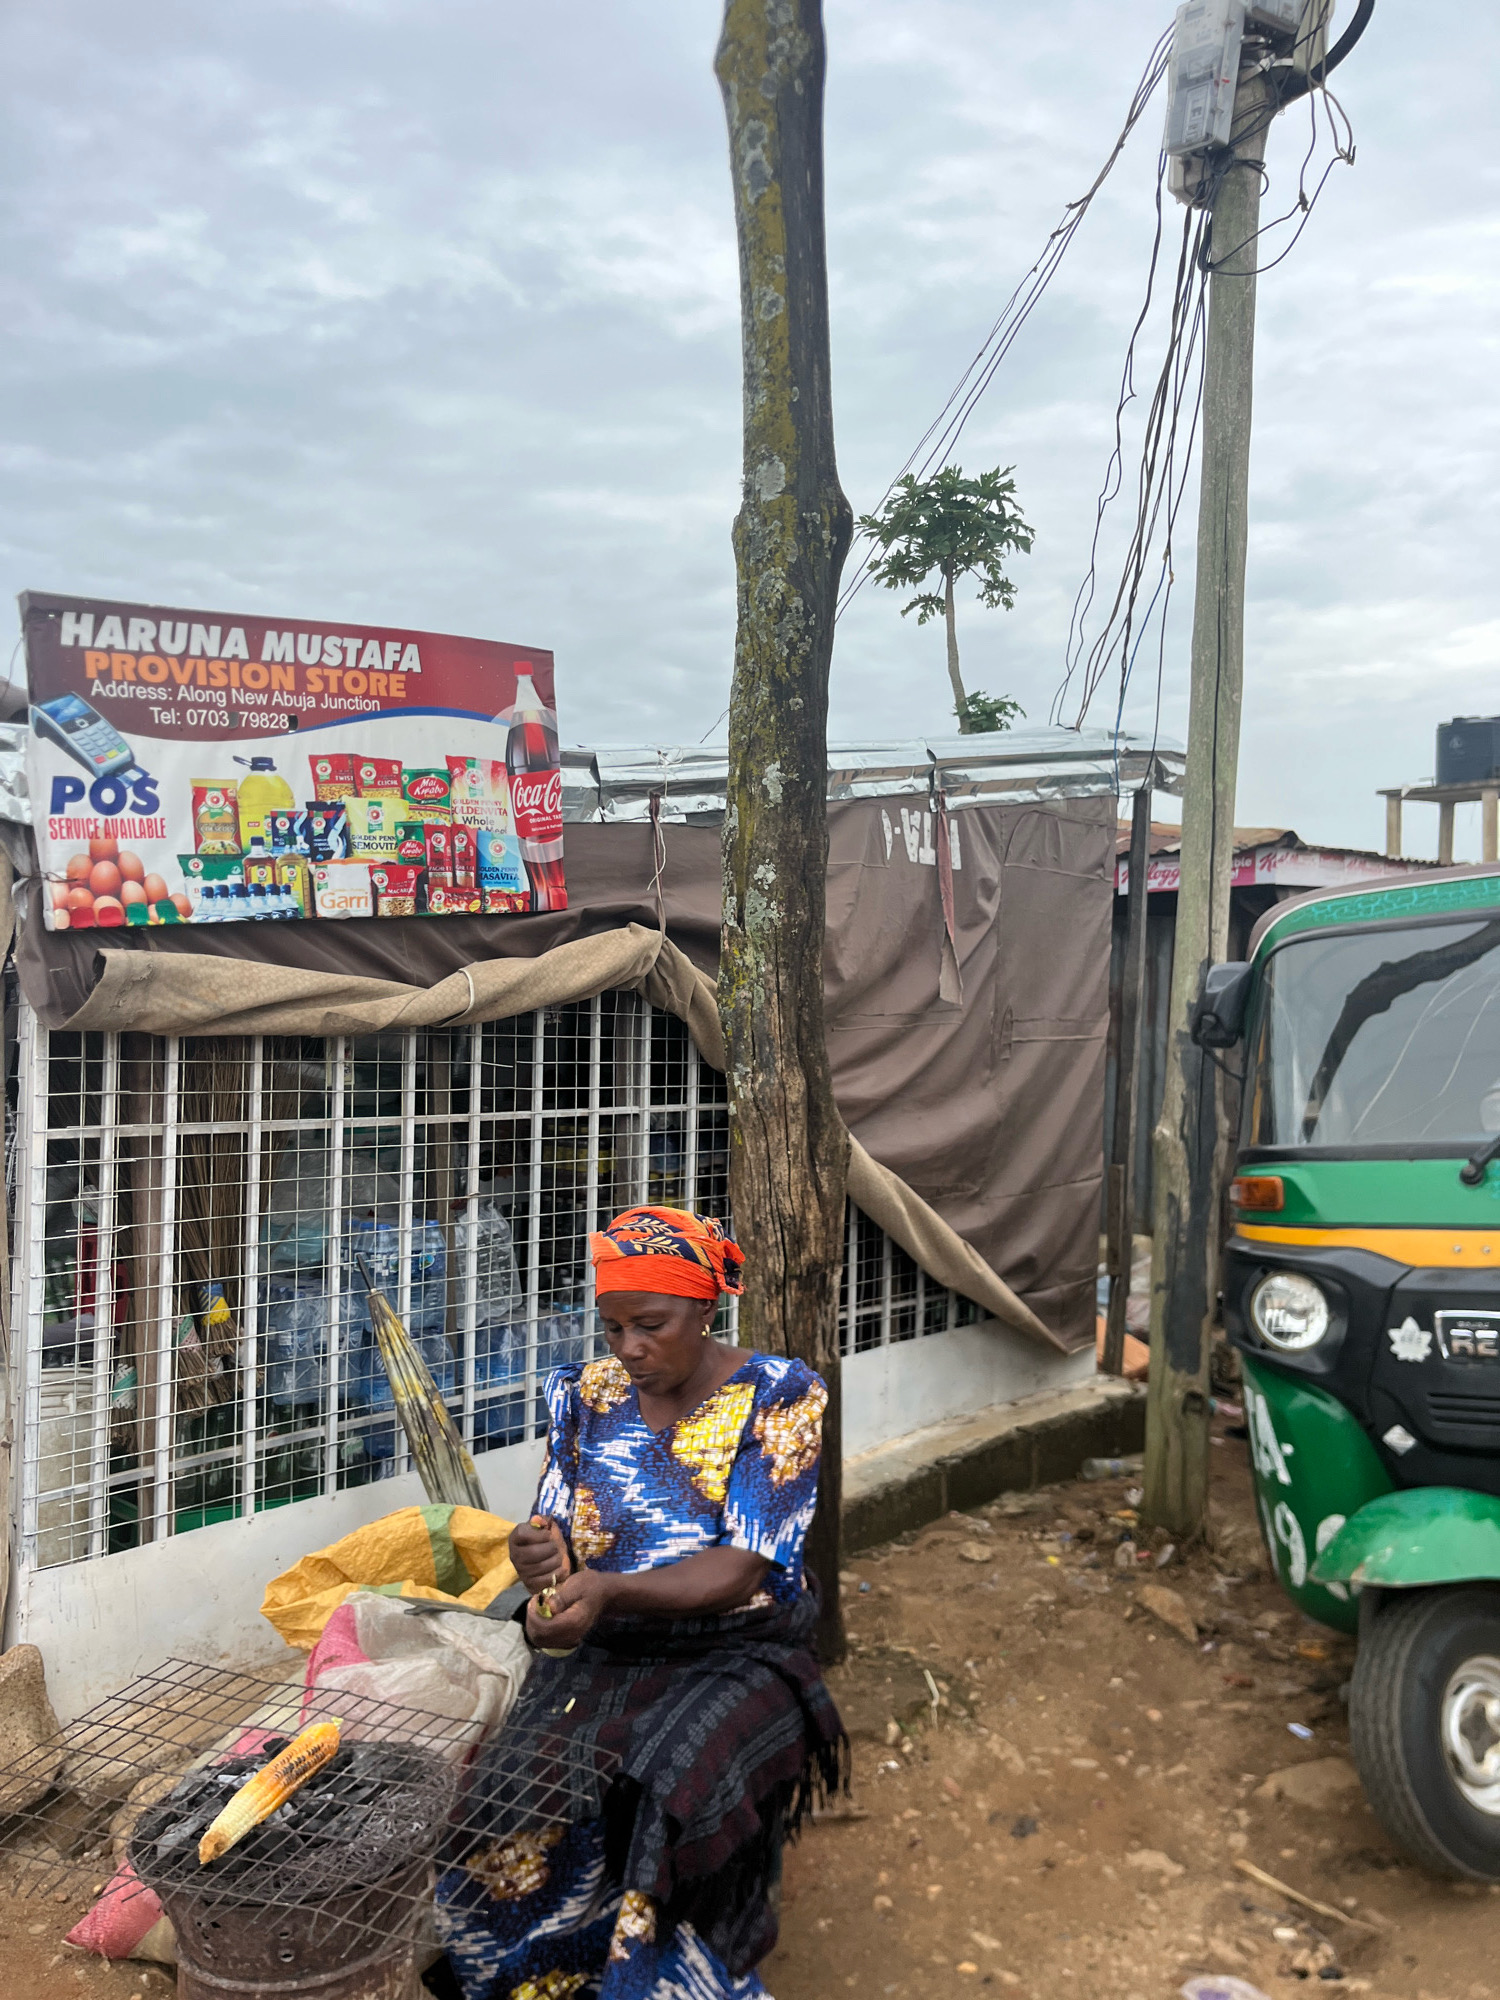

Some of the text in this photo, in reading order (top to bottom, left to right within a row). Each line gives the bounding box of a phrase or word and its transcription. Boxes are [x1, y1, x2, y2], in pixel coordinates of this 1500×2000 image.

[60, 611, 422, 674] HARUNA MUSTAFA
[84, 651, 406, 698] PROVISION STORE
[91, 679, 381, 711] Address: Along New Abuja Junction
[149, 706, 181, 725] Tel:
[49, 775, 160, 816] POS
[48, 818, 167, 840] SERVICE AVAILABLE
[462, 816, 495, 825] Whole
[320, 891, 368, 909] Garri
[1449, 1328, 1499, 1357] RE
